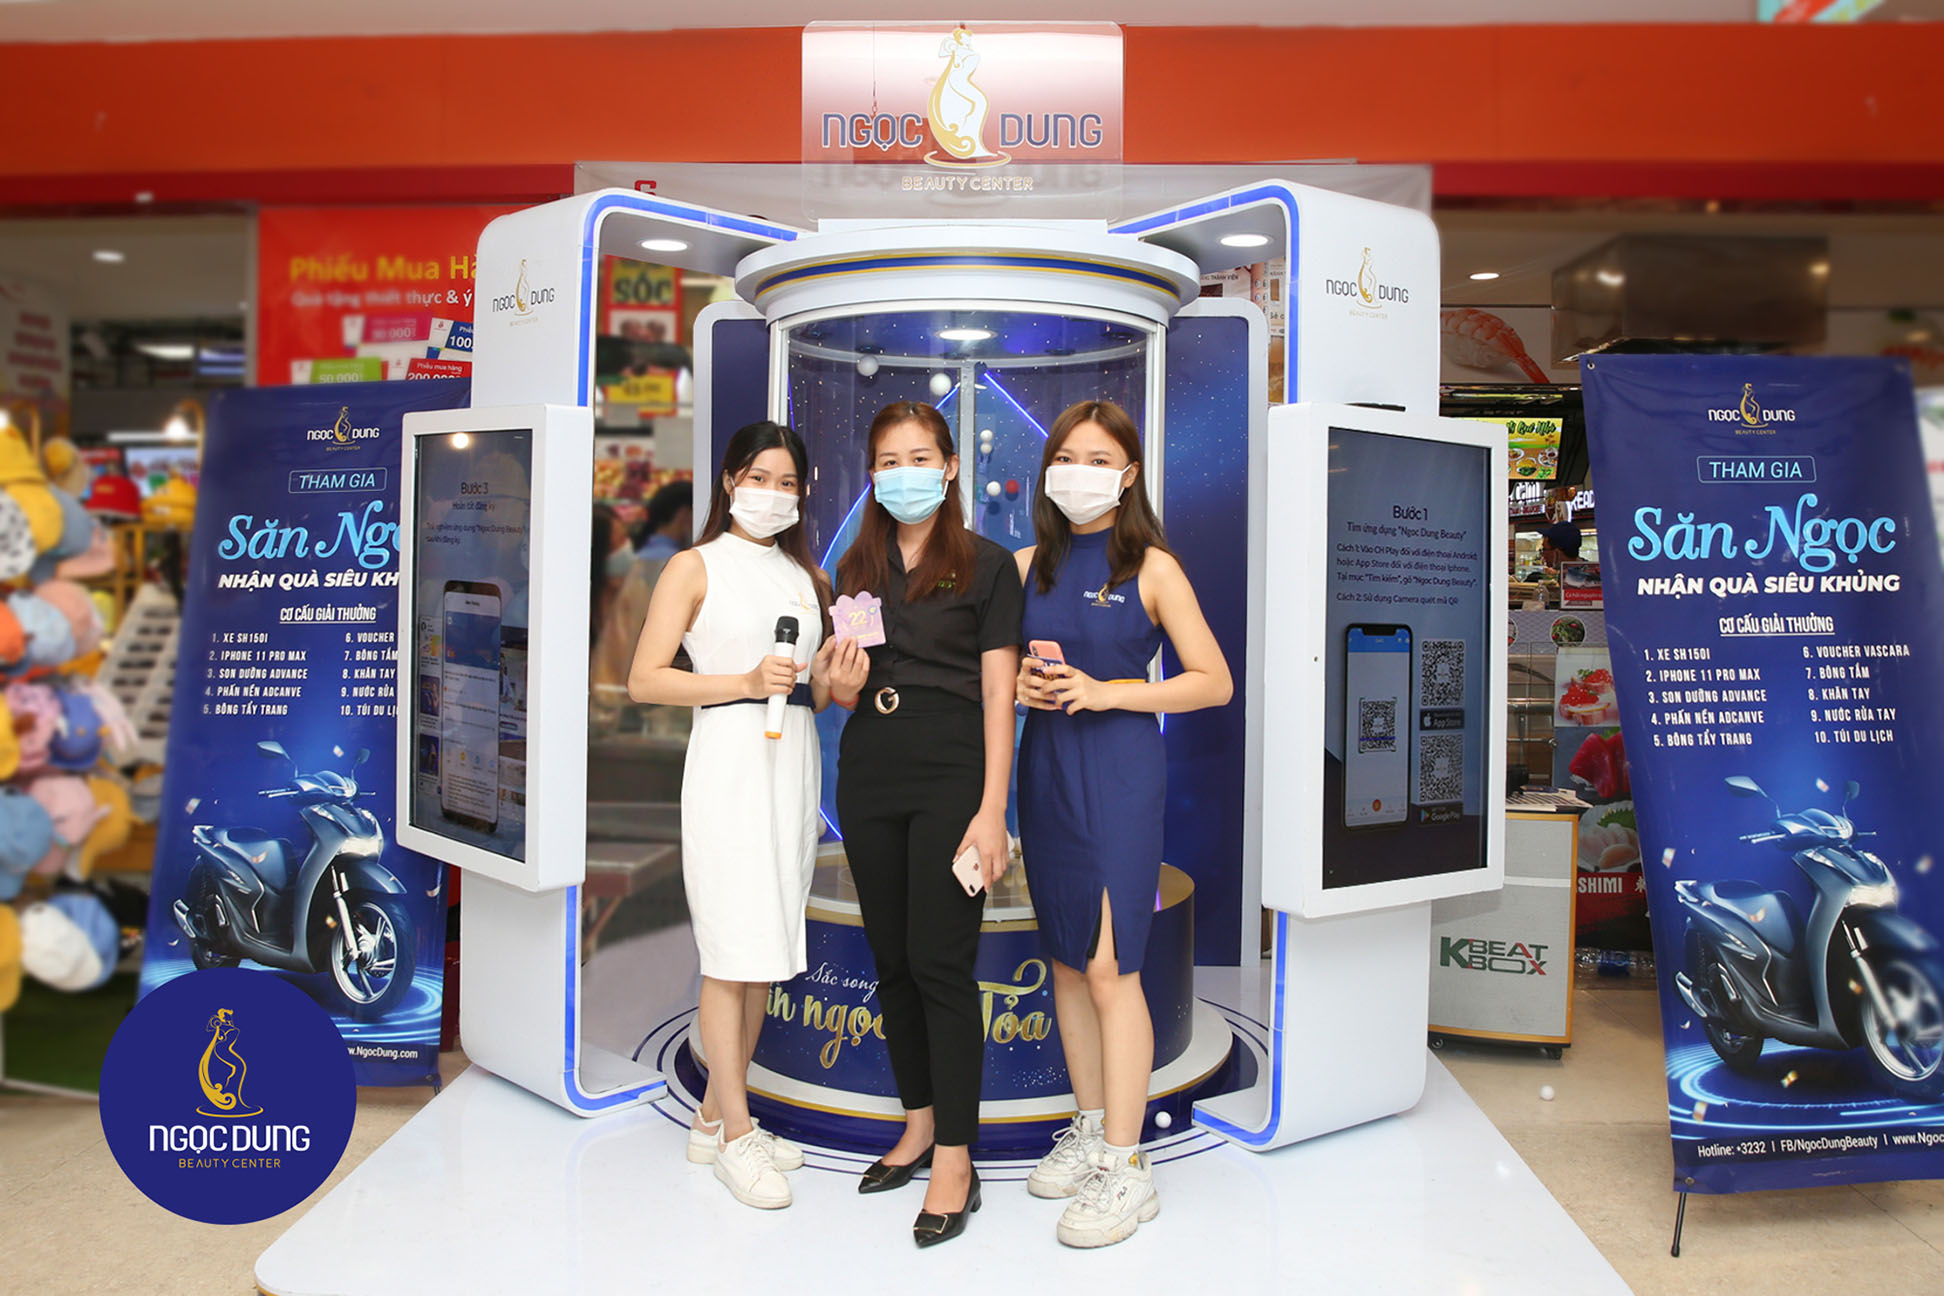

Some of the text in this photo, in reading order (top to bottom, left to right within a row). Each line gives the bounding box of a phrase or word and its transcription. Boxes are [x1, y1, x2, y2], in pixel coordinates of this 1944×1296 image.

[822, 113, 1104, 152] NGỌC DUNG
[902, 175, 1034, 192] BEAUTY CENTER
[377, 255, 440, 281] Mua
[446, 289, 459, 304] &
[530, 288, 555, 305] DUNG
[1708, 408, 1796, 424] NGỌC DUNG
[352, 427, 380, 439] DUNG
[1709, 461, 1802, 479] THAM GIA
[299, 473, 376, 489] THAM GIA
[1393, 505, 1422, 520] Bước
[217, 514, 310, 560] Săn
[1627, 505, 1738, 561] Săn
[1744, 493, 1896, 573] Ngọc
[218, 568, 399, 592] NHẬN QUÀ SIÊU KH
[1637, 570, 1901, 599] NHẬN QUÀ SIÊU KHỦNG
[280, 606, 294, 621] CƠ
[294, 604, 314, 621] CẤU
[849, 610, 867, 626] 22
[1719, 612, 1834, 633] CƠ CẤU GIẢI THƯỞNG
[223, 633, 235, 643] XE
[345, 632, 395, 642] 6. VOUCHER
[209, 650, 307, 661] 2. IPHONE 11 PRO MAX
[344, 650, 352, 661] 7.
[355, 648, 378, 661] BÔNG
[1643, 647, 1710, 661] 1. XE SH150I
[1802, 644, 1911, 659] 6. VOUCHER VASCARA
[207, 669, 216, 679] 3.
[219, 668, 236, 679] SON
[269, 668, 308, 679] ADVANCE
[342, 668, 351, 679] 8.
[379, 668, 395, 679] TAY
[1645, 668, 1761, 682] 2. IPHONE 11 PRO MAX
[1805, 667, 1816, 680] 7.
[1819, 664, 1846, 679] BÔNG
[204, 687, 214, 697] 4.
[262, 686, 302, 697] ADCANVE
[341, 687, 349, 697] 9.
[1648, 692, 1659, 704] 3.
[1662, 691, 1682, 704] SON
[1722, 690, 1767, 702] ADVANCE
[1808, 687, 1819, 701] 8.
[1851, 687, 1870, 700] TAY
[203, 704, 212, 714] 5.
[215, 702, 239, 715] BÔNG
[260, 704, 288, 715] TRANG
[341, 703, 399, 717] 10. TÚI DU LỊ
[1811, 710, 1821, 722] 9.
[1877, 707, 1896, 721] TAY
[1651, 712, 1662, 725] 4.
[1718, 711, 1764, 724] ADCANVE
[1653, 734, 1664, 747] 5.
[1667, 731, 1694, 746] BÔNG
[1720, 732, 1753, 745] TRANG
[1814, 727, 1894, 745] 10. TÚI DU LỊCH
[1468, 954, 1548, 976] BOX
[843, 977, 879, 1003] song
[977, 958, 1053, 1044] Tỏa
[347, 1046, 418, 1060] w.NgocDung.com
[1698, 1144, 1735, 1158] Hotline:
[1781, 1134, 1878, 1155] FB/NgocDungBeauty
[1893, 1131, 1944, 1147] www.Ngoc
